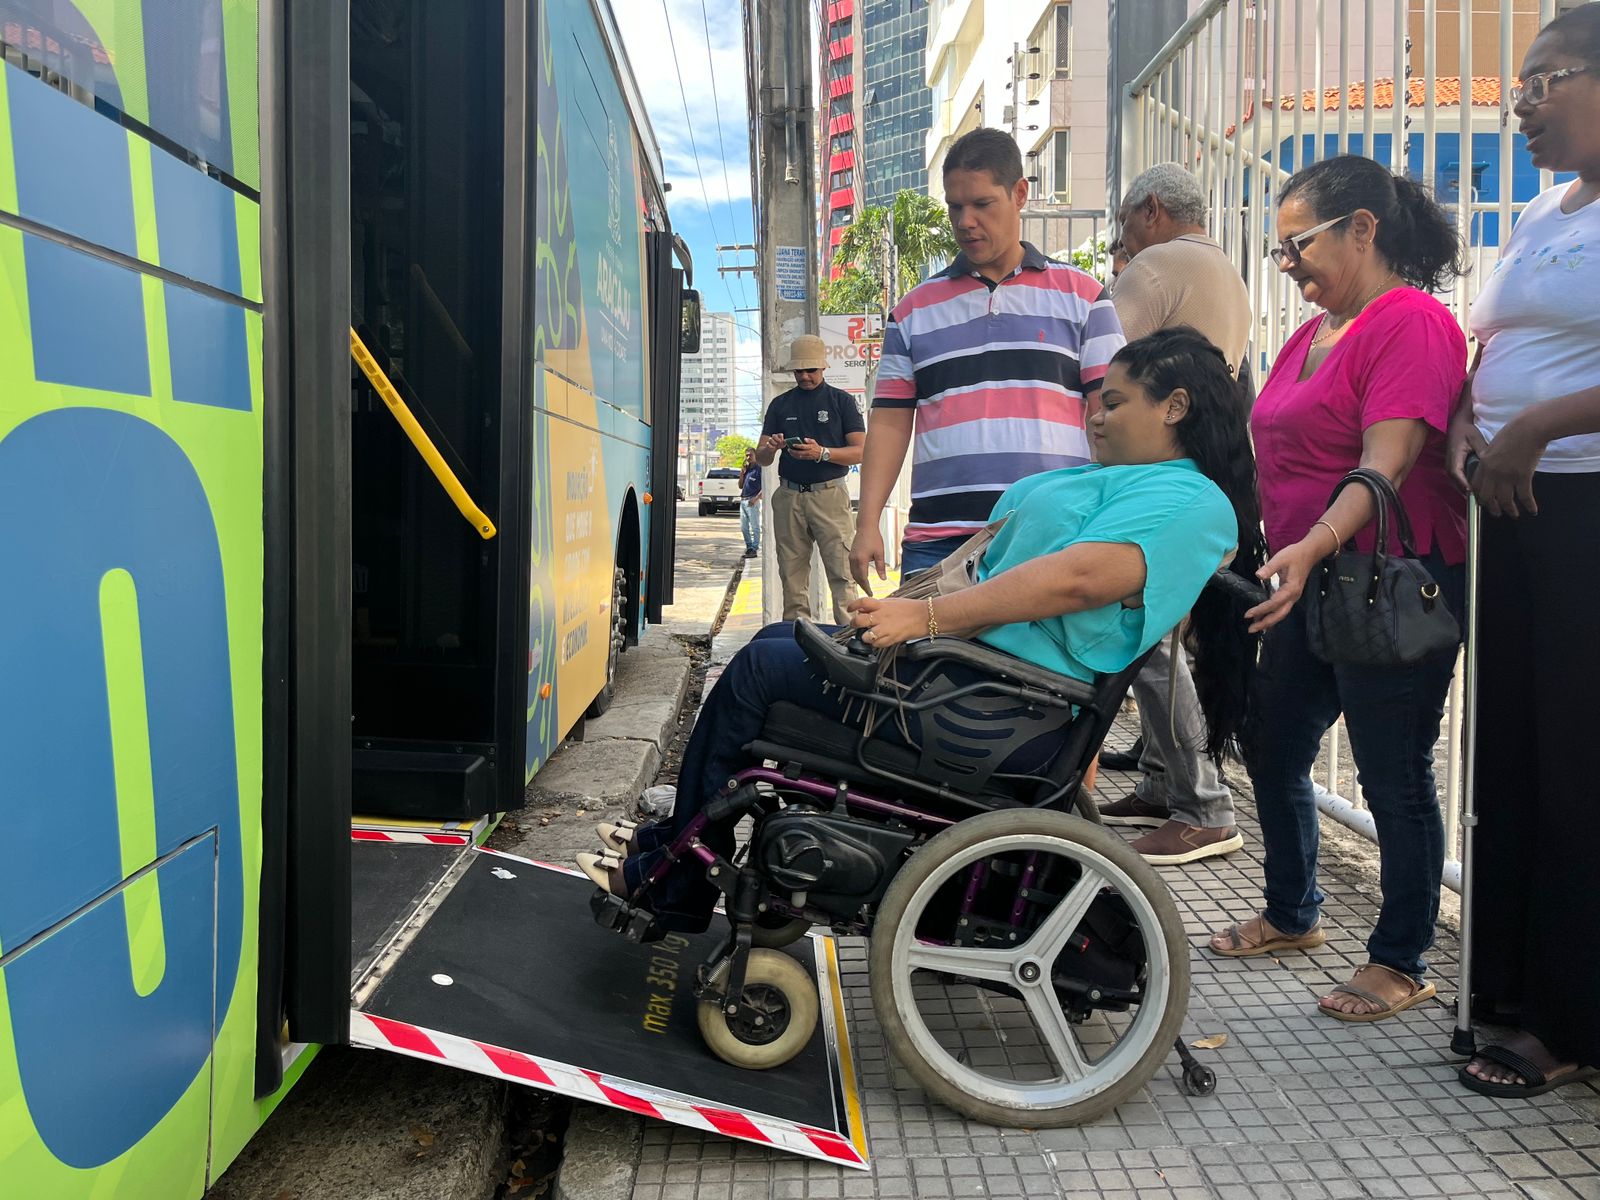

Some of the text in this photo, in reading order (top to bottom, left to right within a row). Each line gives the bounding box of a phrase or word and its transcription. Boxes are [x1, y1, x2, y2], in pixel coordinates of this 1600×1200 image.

[597, 251, 631, 331] ARACAJU
[651, 934, 690, 954] kg
[646, 956, 680, 991] 350
